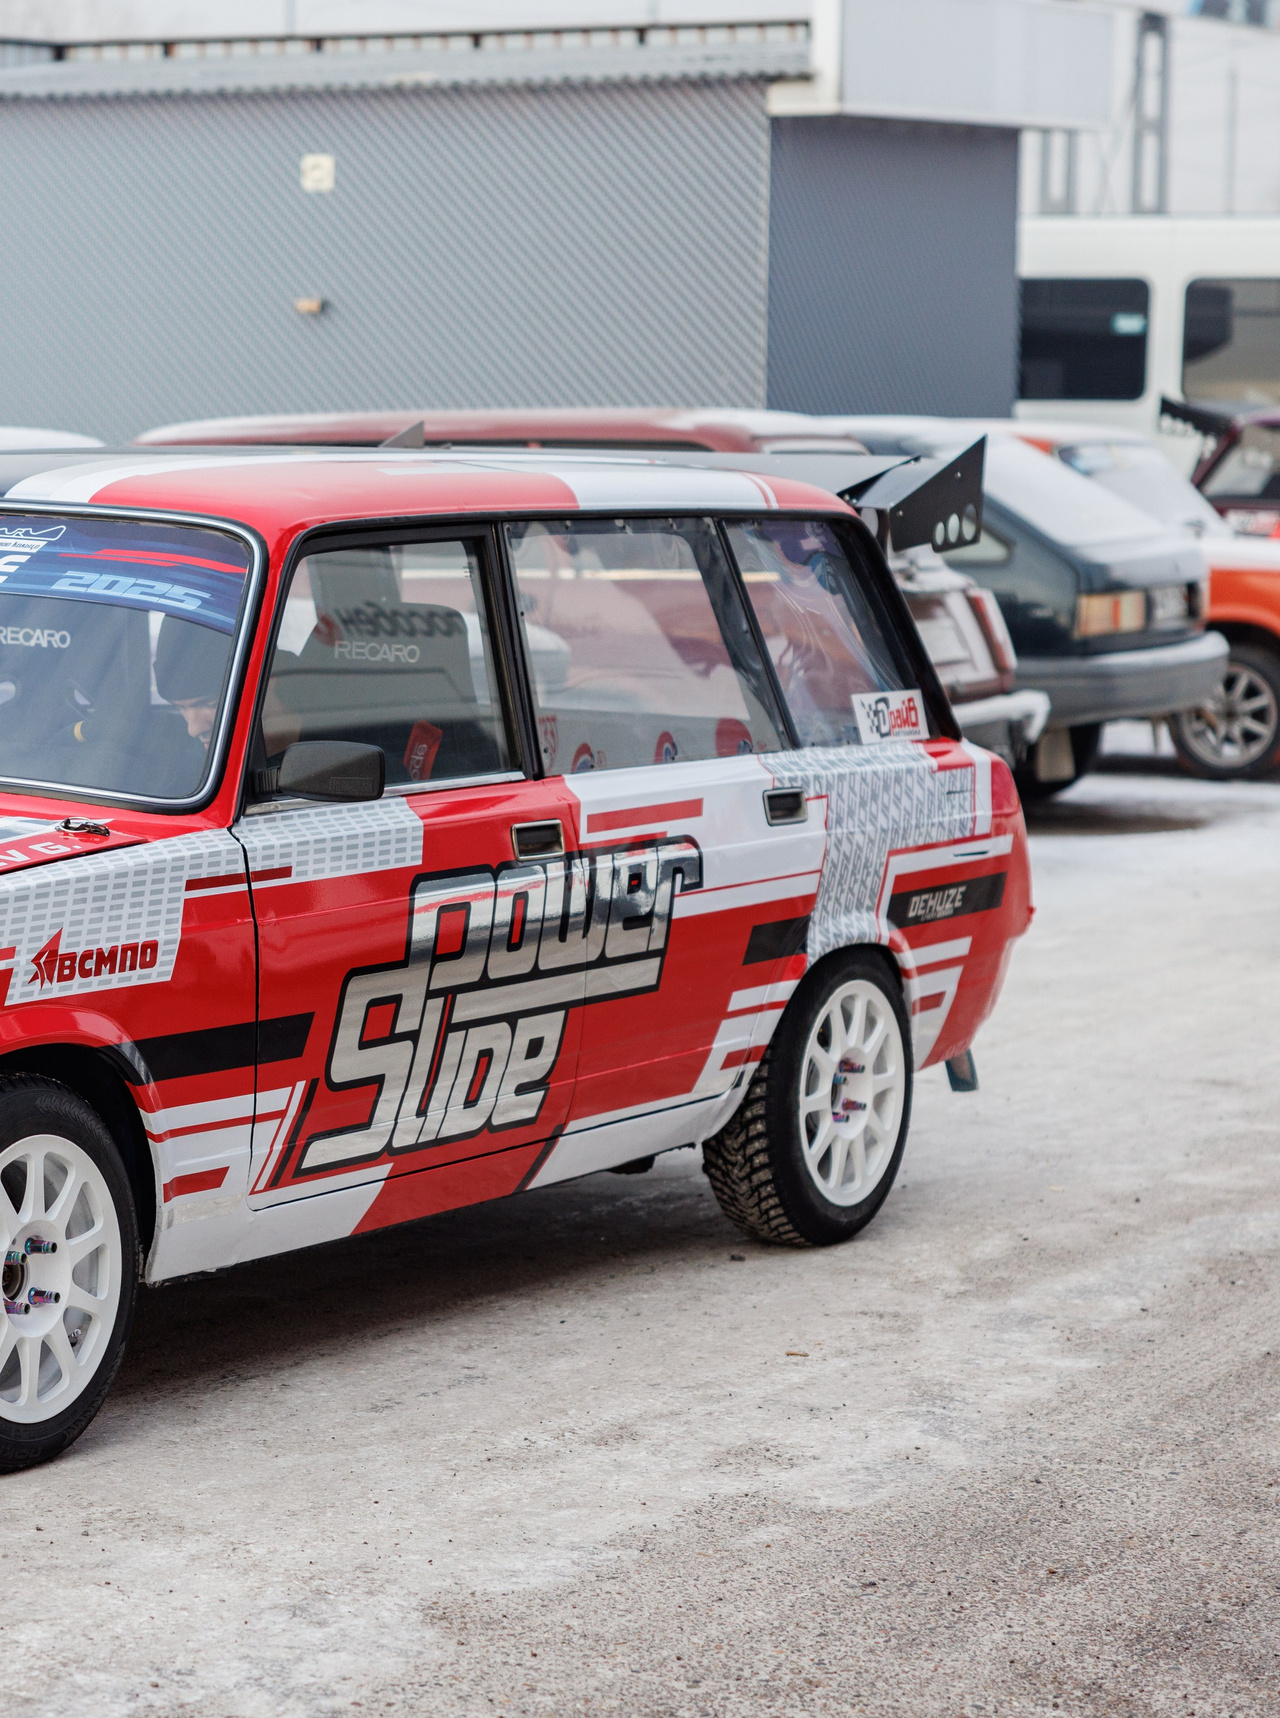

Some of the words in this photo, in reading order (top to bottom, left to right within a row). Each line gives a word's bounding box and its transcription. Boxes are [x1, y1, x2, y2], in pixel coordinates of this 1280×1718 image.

[50, 570, 213, 610] 2025
[334, 640, 420, 663] RECARO
[28, 841, 82, 857] G.
[907, 885, 967, 918] DEHUZE
[56, 939, 160, 983] ВСМПО
